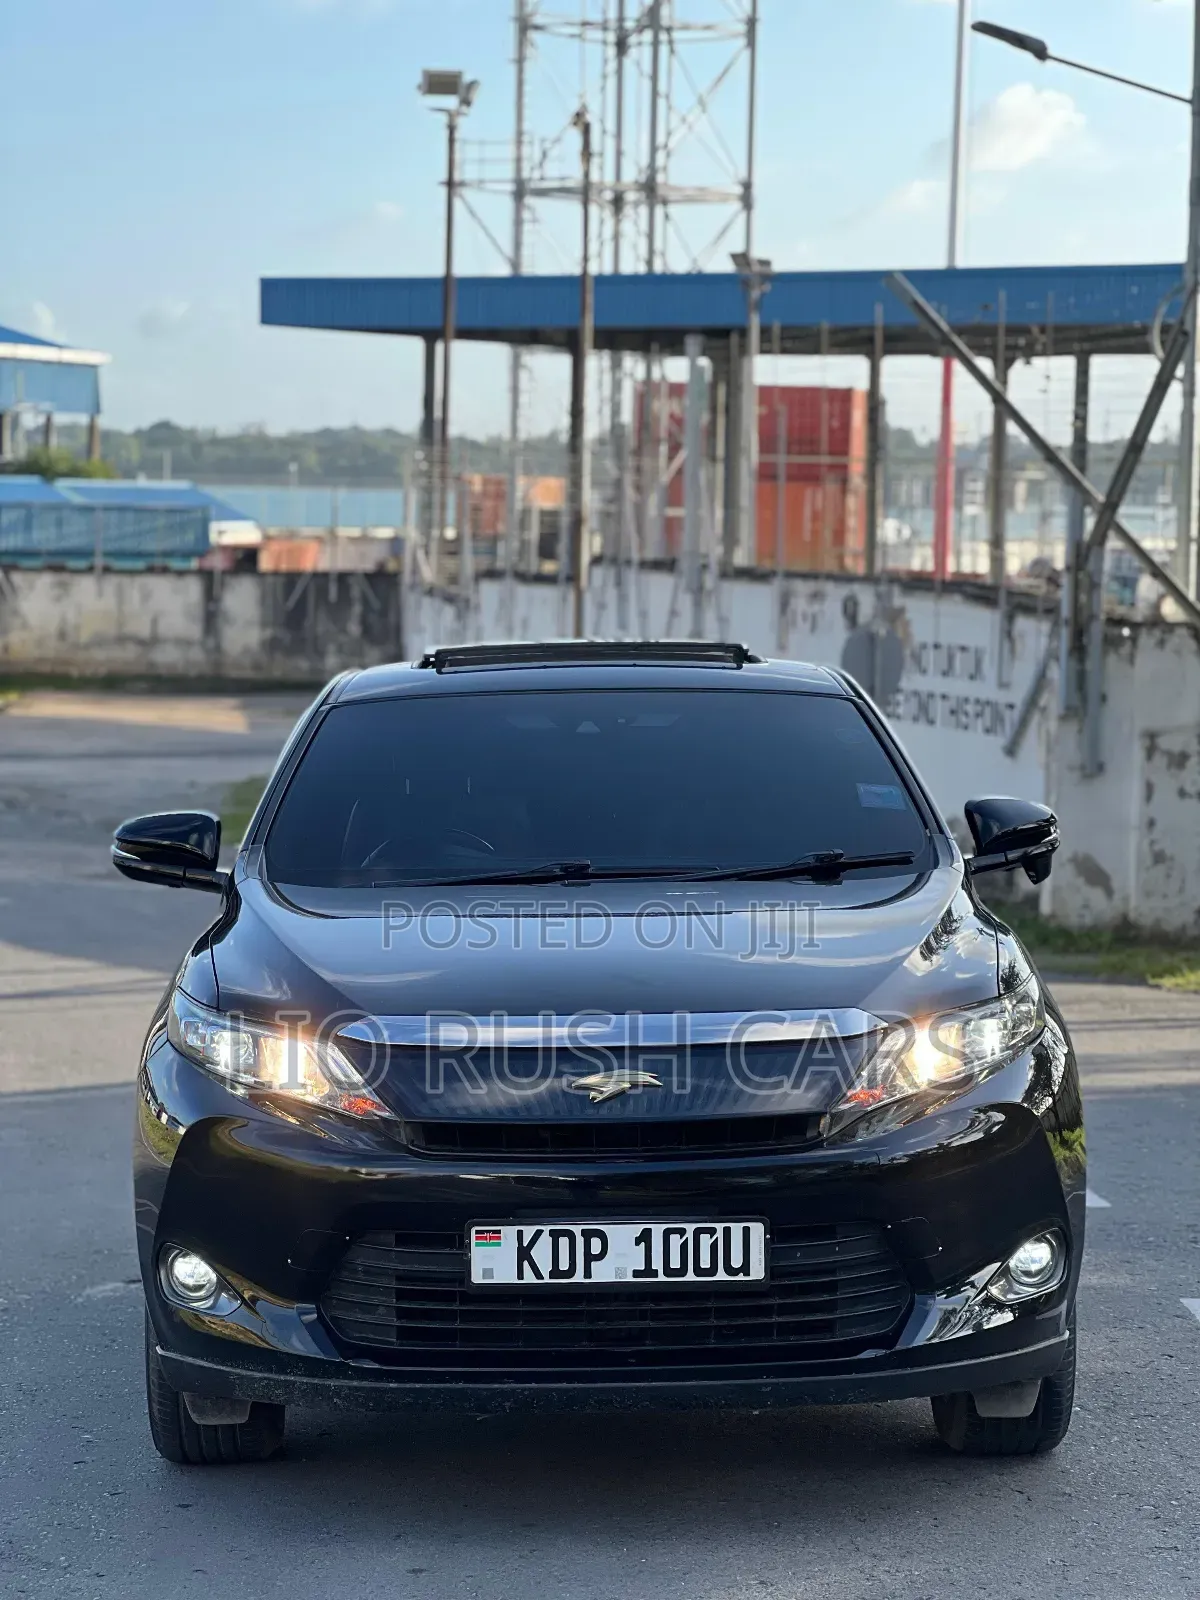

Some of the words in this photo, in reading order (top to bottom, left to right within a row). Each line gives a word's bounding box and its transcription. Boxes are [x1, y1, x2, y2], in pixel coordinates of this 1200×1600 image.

[938, 693, 970, 732] THIS
[516, 1228, 609, 1280] KDP
[632, 1225, 751, 1278] 100U
